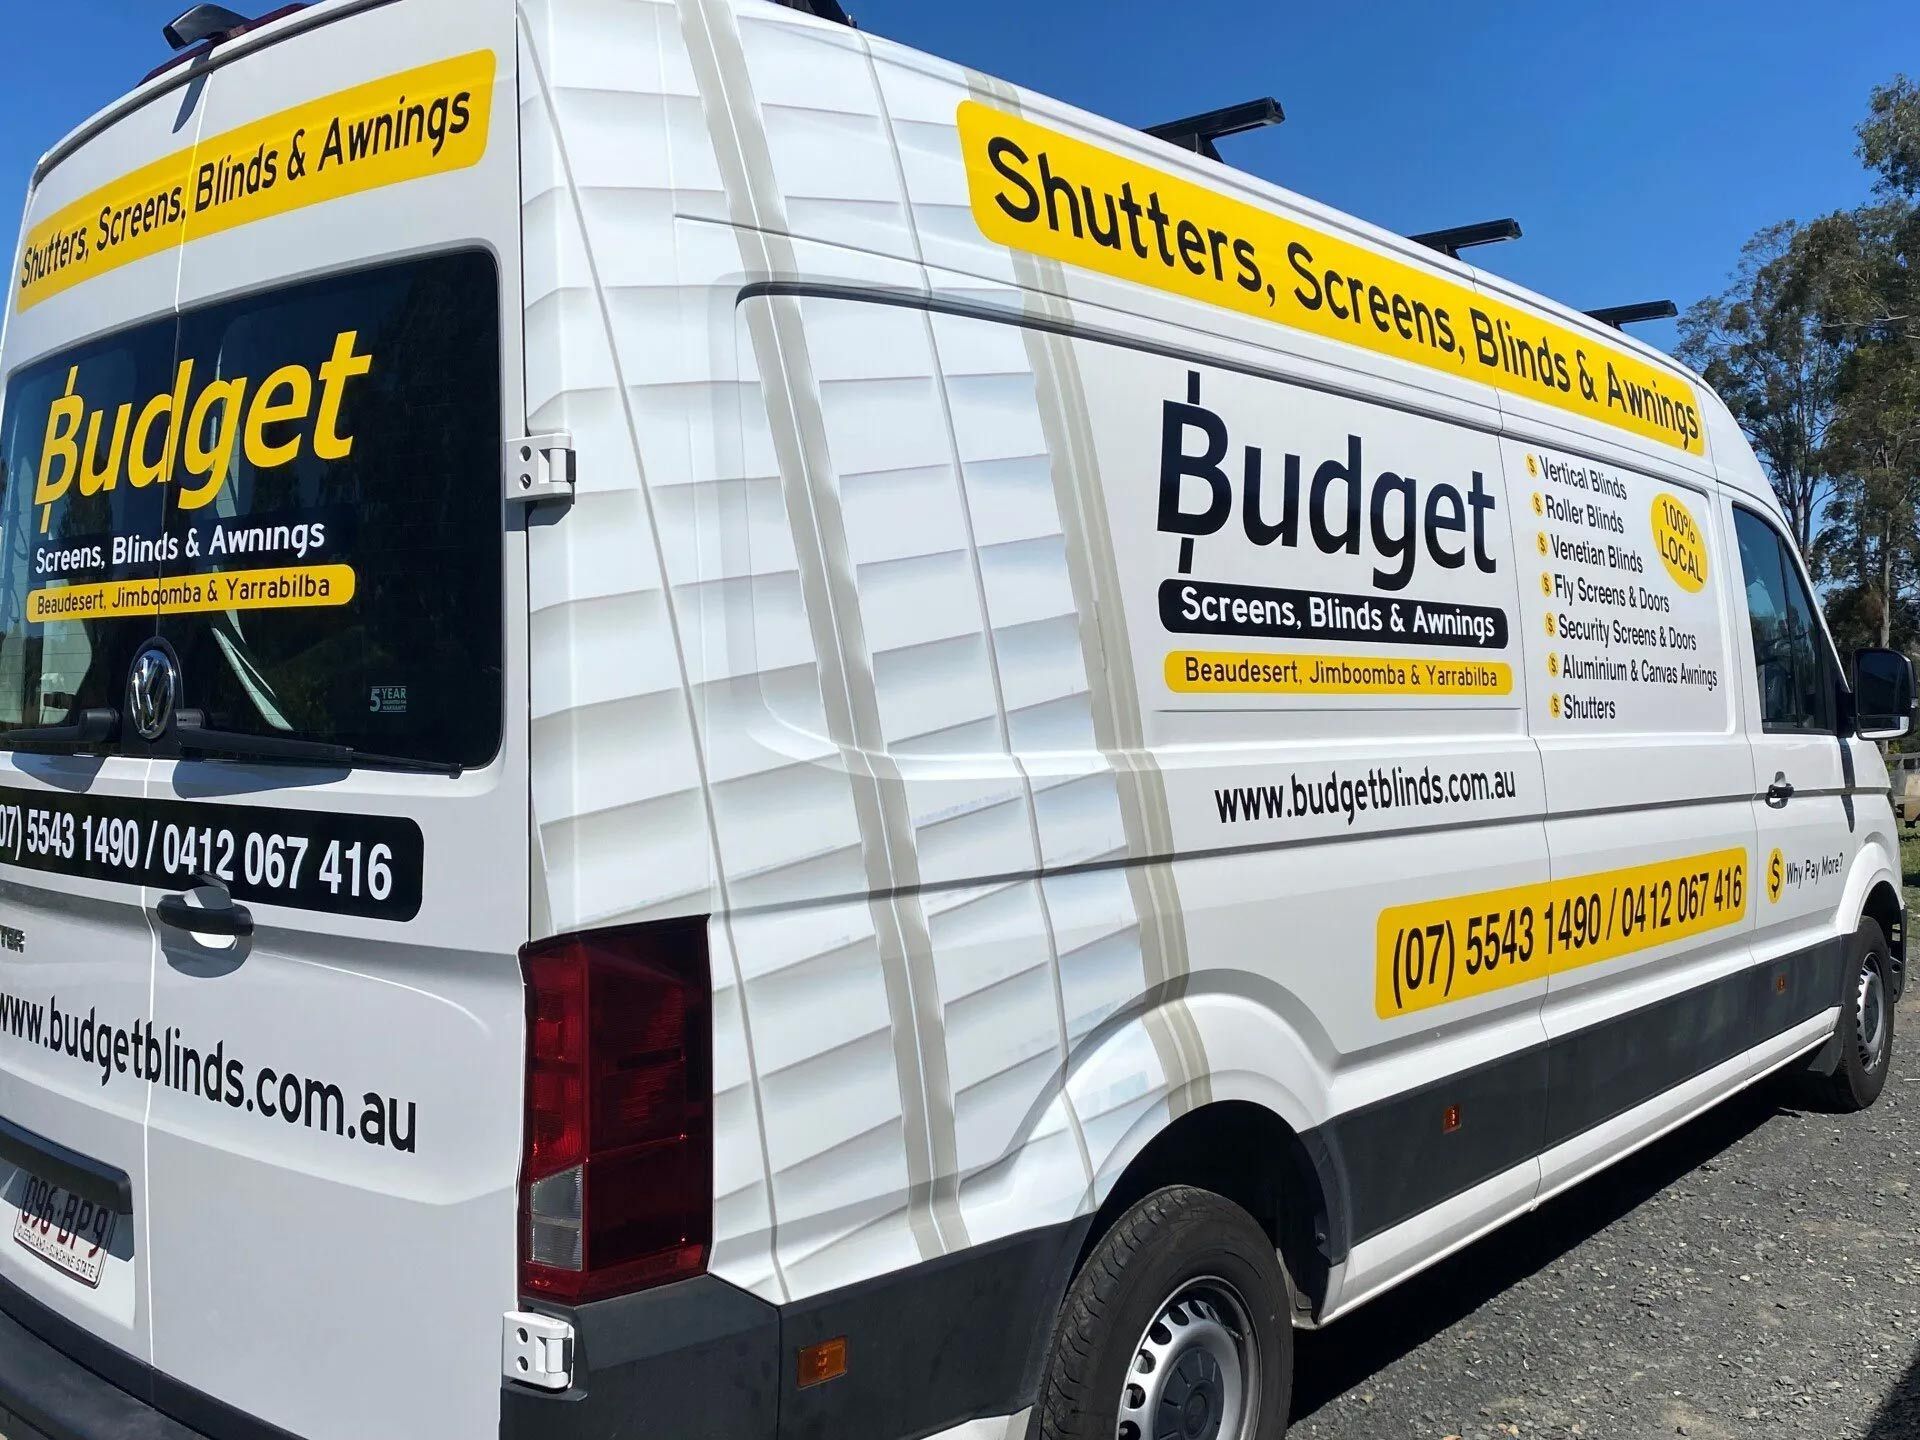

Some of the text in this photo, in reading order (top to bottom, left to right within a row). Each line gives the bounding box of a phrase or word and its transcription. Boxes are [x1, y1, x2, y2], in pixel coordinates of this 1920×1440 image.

[21, 90, 471, 288] Shutters, Screens, Blinds & Awnings
[987, 136, 1700, 451] Shutters, Screens, Blinds & Awnings
[35, 330, 372, 533] Budget
[1157, 370, 1496, 591] Budget
[1539, 455, 1588, 490] Vertical
[1591, 470, 1627, 500] Blinds
[1545, 495, 1584, 524] Roller
[1587, 504, 1624, 533] Blinds
[1662, 500, 1696, 545] 100%
[35, 522, 325, 574] Screens, Blinds & Awnings
[1551, 533, 1605, 566] Venetian
[1608, 546, 1643, 573] Blinds
[1660, 529, 1704, 584] LOCAL
[37, 574, 330, 614] Beaudesert, Jimboomba & Yarrabilba
[1181, 586, 1495, 644] Screens, Blinds & Awnings
[1554, 573, 1574, 606] Fly
[1578, 577, 1625, 607] Screens
[1629, 587, 1637, 608] &
[1639, 590, 1670, 612] Doors
[1559, 613, 1610, 648] Security
[1613, 620, 1656, 647] Screens
[1659, 628, 1667, 648] &
[1668, 626, 1697, 650] Doors
[1185, 656, 1497, 686] Beaudesert, Jimboomba & Yarrabilba
[1563, 654, 1628, 681] Aluminium
[1631, 659, 1639, 681] &
[1641, 660, 1678, 684] Canvas
[1680, 663, 1718, 691] Awnings
[370, 688, 406, 711] 5 YEAR
[1564, 694, 1616, 719] Shutters
[1214, 765, 1516, 826] www.budgetblinds.com.au
[27, 809, 74, 859] 5543
[82, 815, 139, 868] 1490
[145, 820, 158, 870] /
[163, 823, 234, 881] 0412
[245, 833, 308, 888] 067
[319, 840, 392, 900] 416
[1786, 862, 1803, 889] Why
[1805, 859, 1820, 885] Pay
[1822, 852, 1843, 876] More?
[1393, 864, 1742, 1009] (07) 5543 1490 / 0412 067 416
[76, 1258, 95, 1278] STATE
